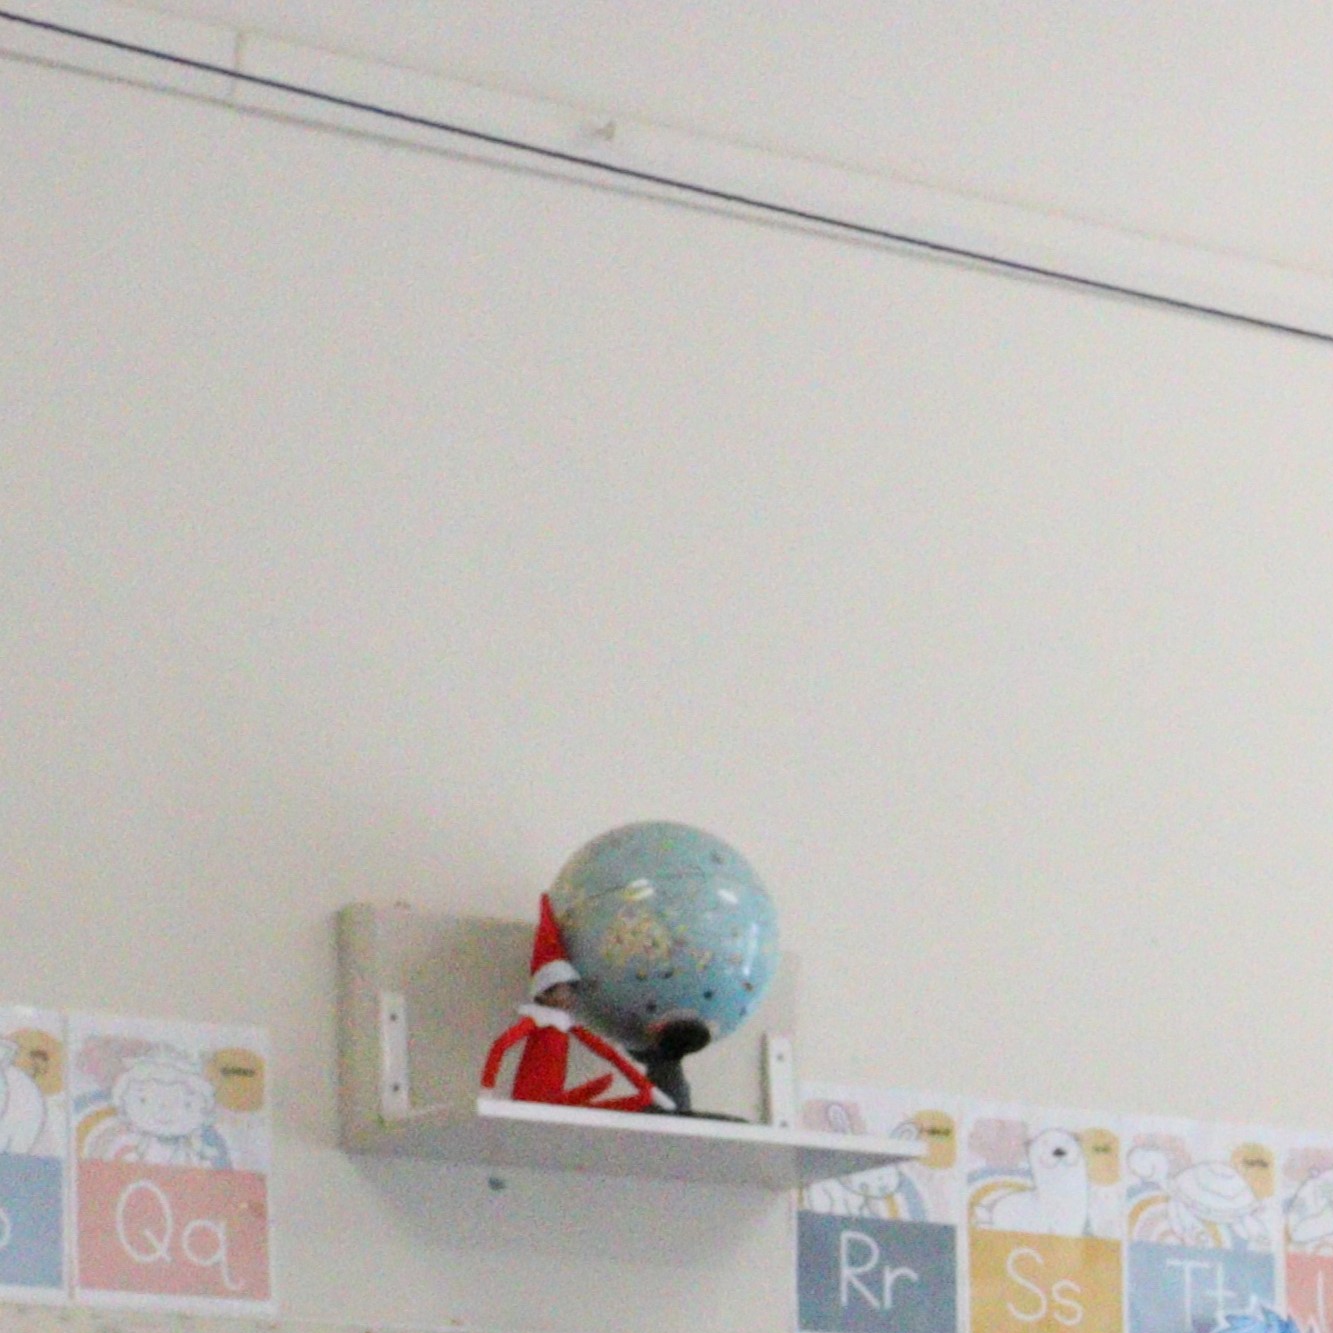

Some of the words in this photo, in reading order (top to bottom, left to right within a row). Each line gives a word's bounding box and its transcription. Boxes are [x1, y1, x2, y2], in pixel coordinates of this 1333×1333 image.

[116, 1178, 244, 1293] Qq
[838, 1230, 919, 1311] Rr
[1004, 1247, 1084, 1327] Ss
